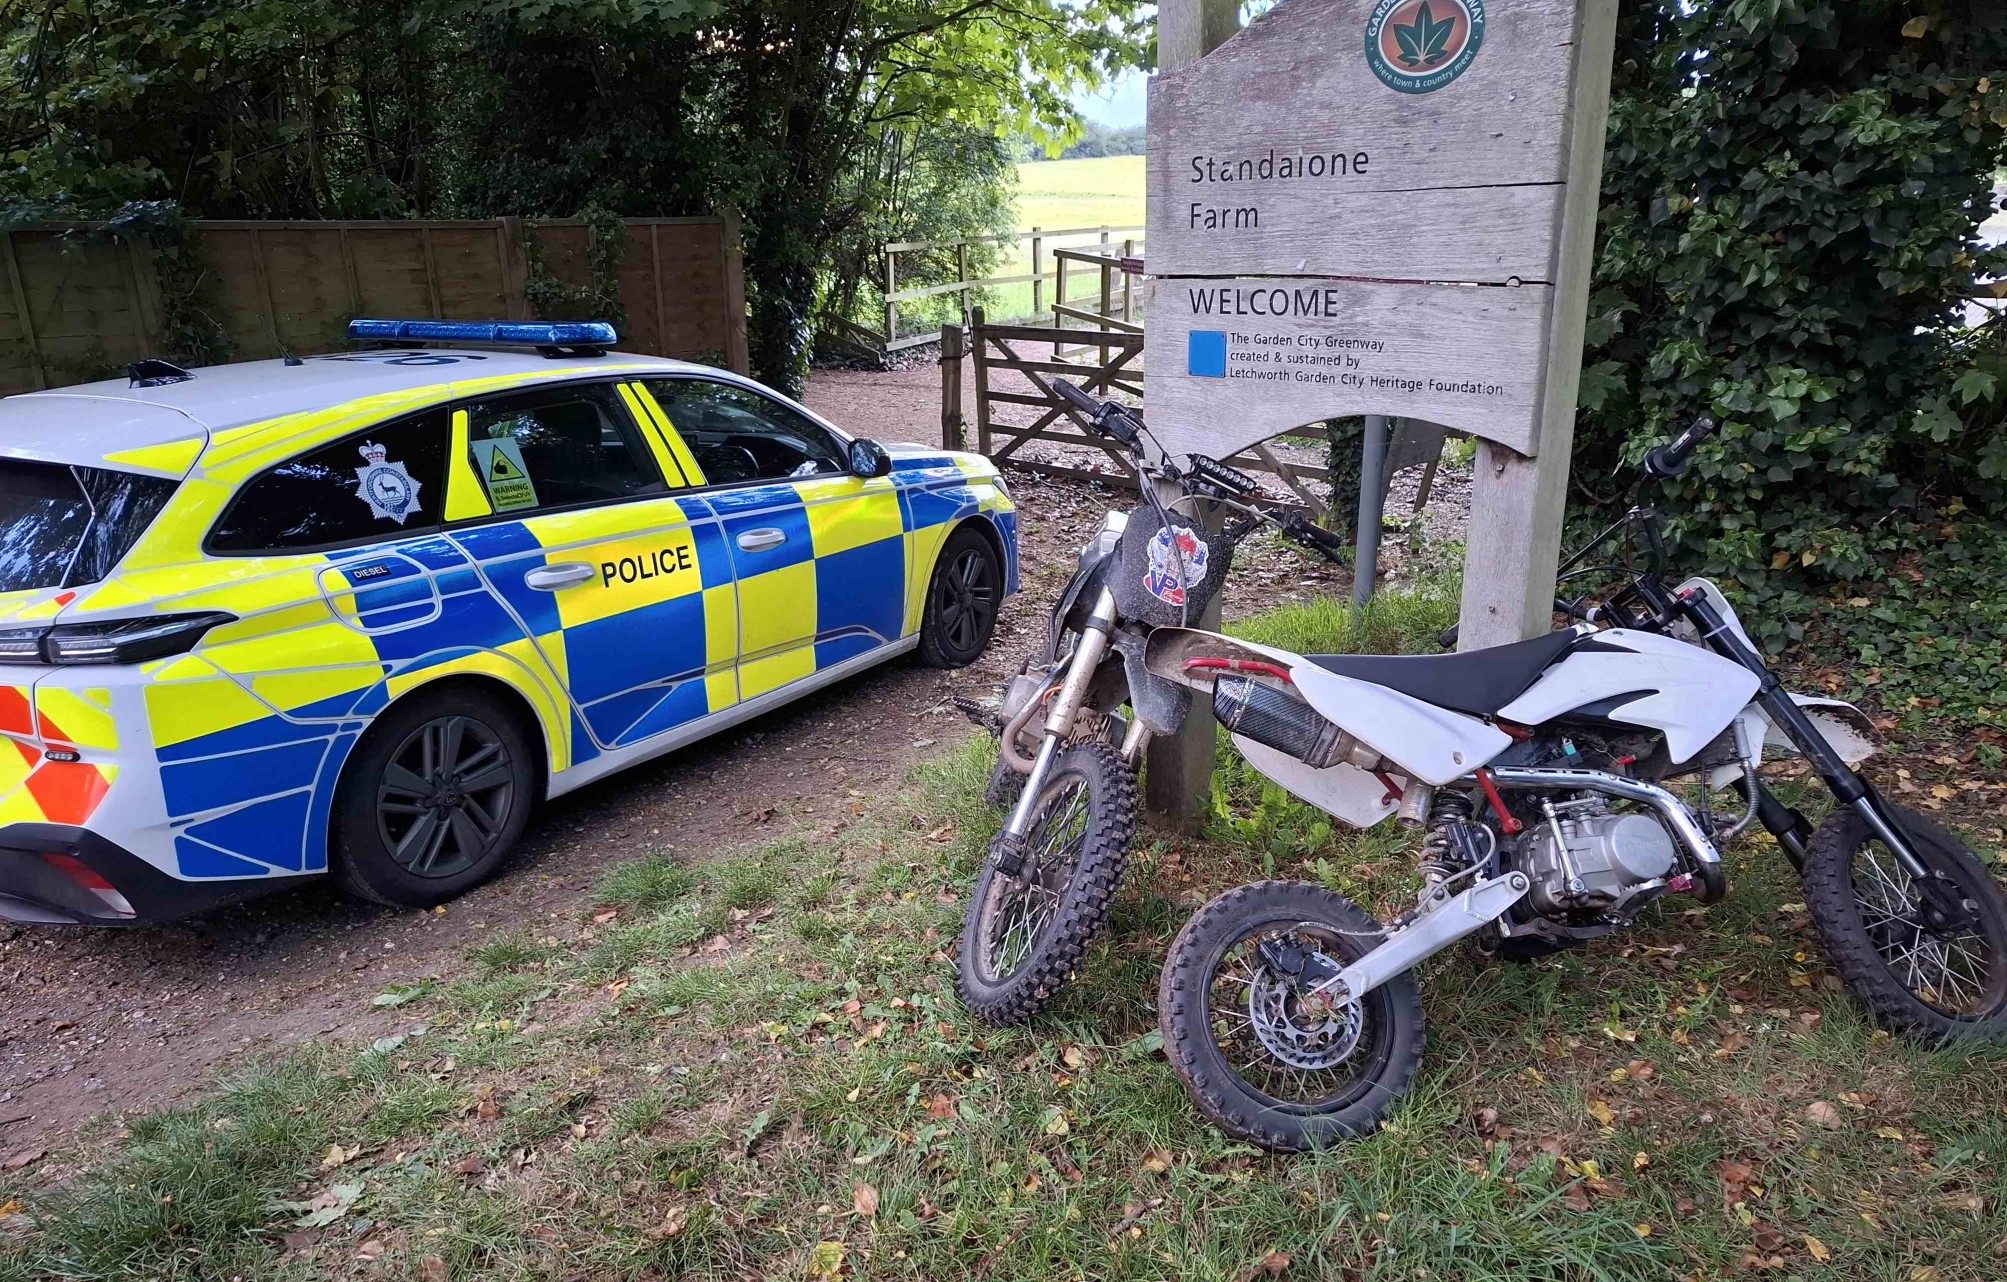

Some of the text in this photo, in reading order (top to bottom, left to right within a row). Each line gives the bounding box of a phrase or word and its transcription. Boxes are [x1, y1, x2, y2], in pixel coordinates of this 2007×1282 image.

[1373, 49, 1475, 88] where town & country meet
[1190, 203, 1258, 230] Farm
[1189, 288, 1338, 317] WELCOME
[1230, 332, 1385, 354] The Garden City Greenway
[1230, 350, 1361, 371] created & sustained by
[1229, 367, 1504, 396] Letchworth Garden City Heritage Foundation
[493, 483, 529, 495] WARNING
[353, 565, 388, 579] DIESEL
[600, 545, 692, 588] POLICE
[1150, 569, 1179, 597] VP
